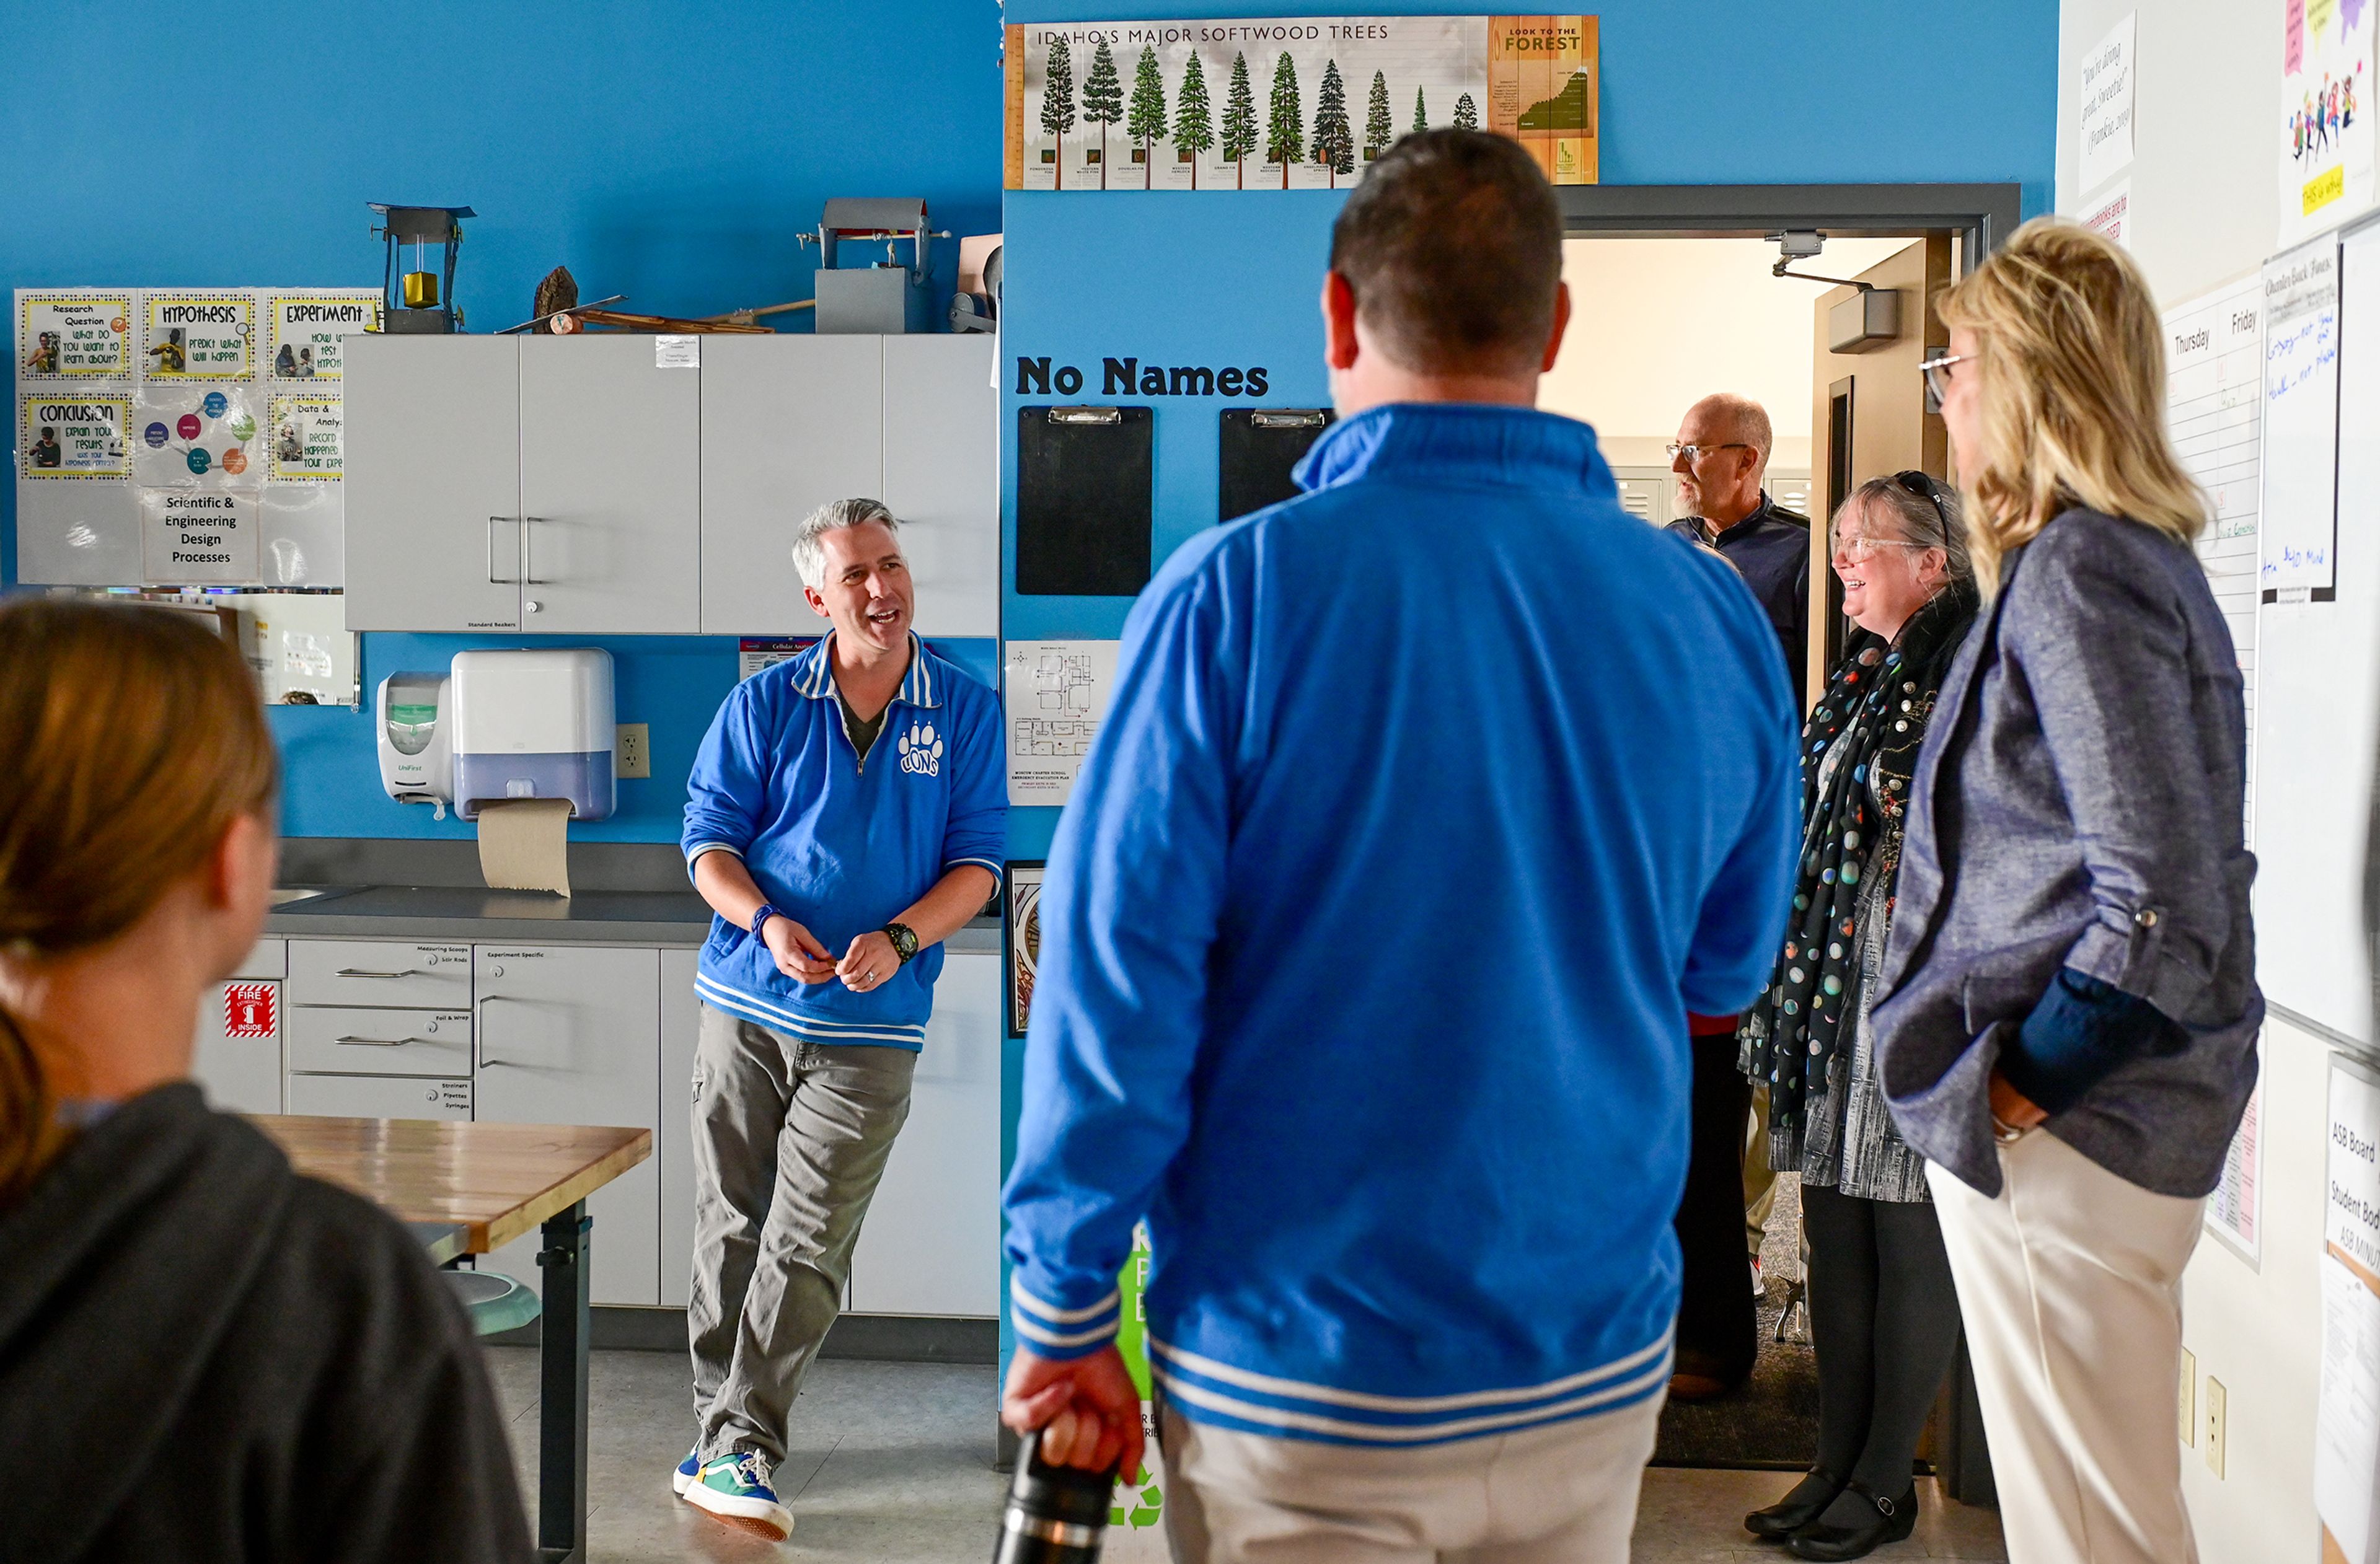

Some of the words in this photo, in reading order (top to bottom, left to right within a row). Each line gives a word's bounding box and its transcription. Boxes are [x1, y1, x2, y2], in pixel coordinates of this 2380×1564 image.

[1038, 30, 1119, 45] IDAHO'S
[1129, 29, 1192, 46] MAJOR
[1201, 25, 1319, 42] SOFTWOOD
[1329, 25, 1388, 39] TREES
[1505, 37, 1580, 51] FOREST
[53, 305, 94, 313] Research
[65, 317, 104, 326] Question
[2232, 309, 2257, 335] Friday
[99, 330, 110, 340] DO
[2175, 327, 2210, 356] Thursday
[1016, 357, 1083, 395] No
[1102, 357, 1269, 397] Names
[298, 405, 319, 413] Data
[322, 405, 329, 413] &
[167, 497, 221, 508] Scientific
[224, 497, 234, 508] &
[165, 516, 236, 529] Engineering
[182, 534, 221, 547] Design
[173, 551, 231, 563] Processes
[902, 750, 938, 775] LIONS
[238, 991, 262, 999] FIRE
[2333, 1122, 2348, 1148] ASB
[2350, 1131, 2375, 1163] Board
[2332, 1180, 2361, 1218] Student
[2340, 1226, 2354, 1251] ASB
